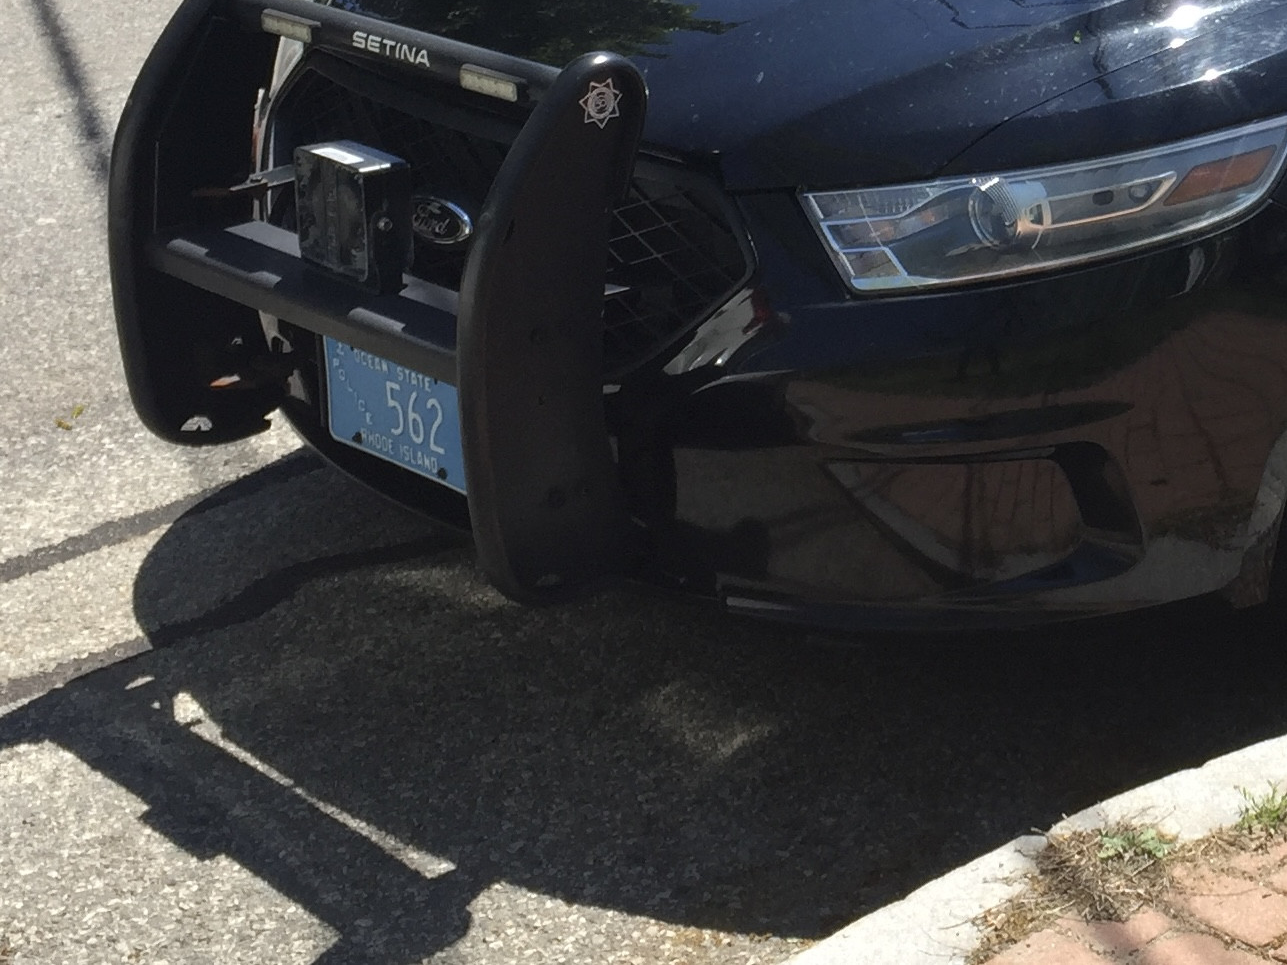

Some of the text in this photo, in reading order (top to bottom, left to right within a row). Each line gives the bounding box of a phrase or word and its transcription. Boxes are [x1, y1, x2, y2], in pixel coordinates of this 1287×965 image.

[352, 30, 430, 68] SETINA
[412, 202, 451, 235] Ford
[353, 347, 431, 393] OCEAN STATE
[385, 380, 446, 455] 562
[360, 427, 438, 473] RHODE ISLAND
